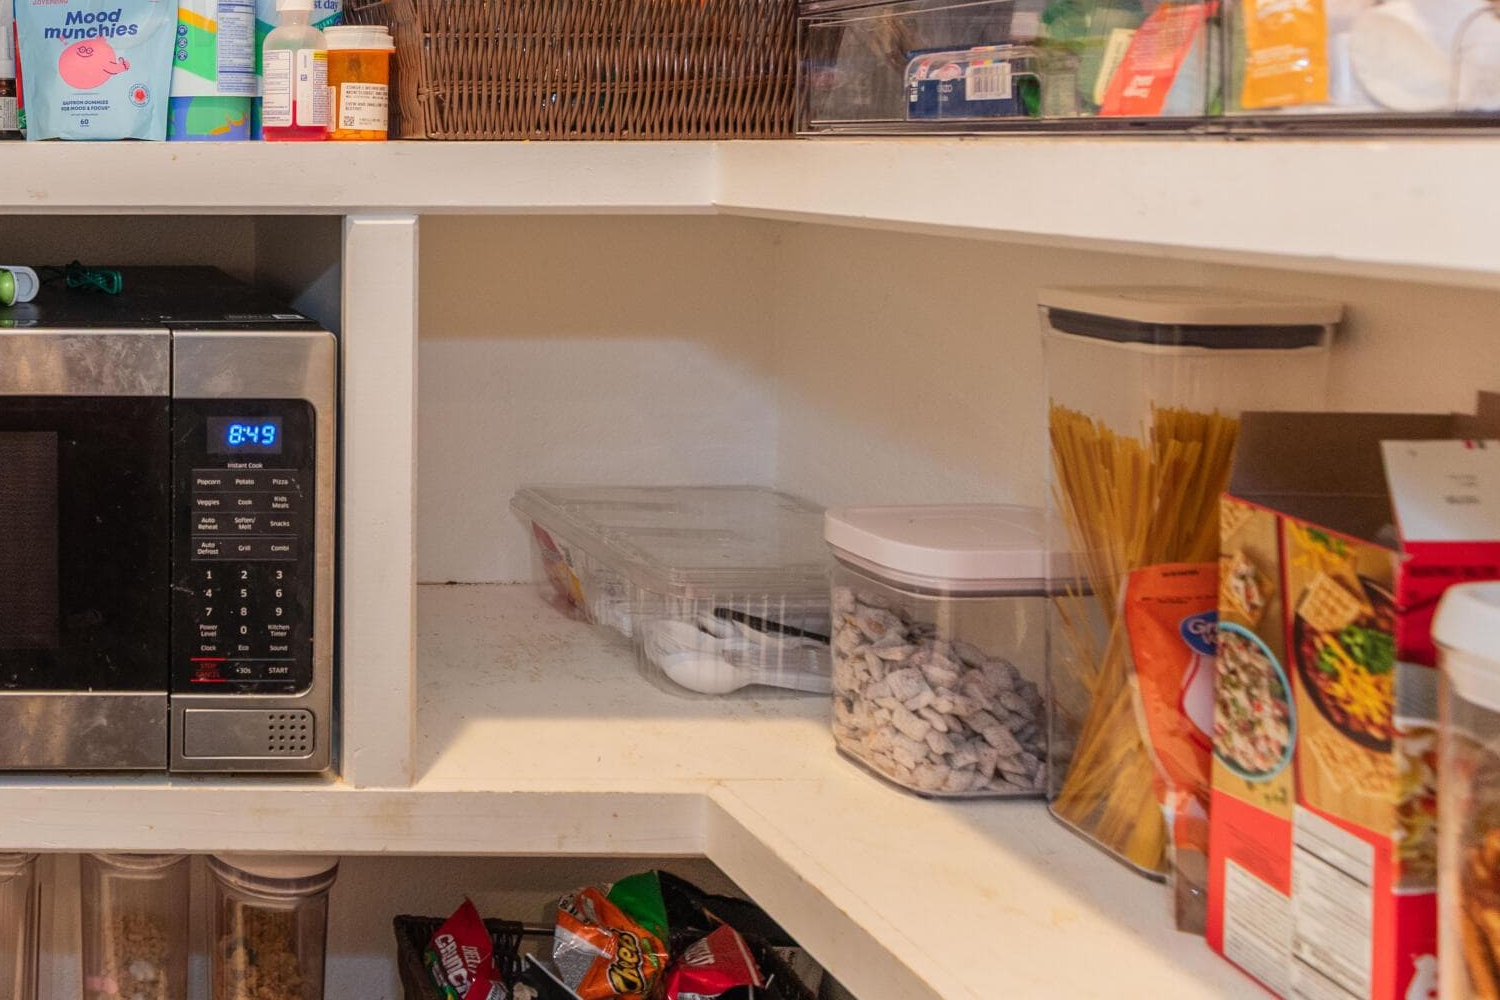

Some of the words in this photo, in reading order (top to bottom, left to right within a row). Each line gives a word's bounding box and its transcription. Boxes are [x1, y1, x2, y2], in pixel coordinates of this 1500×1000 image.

[65, 8, 122, 26] Mood
[44, 23, 139, 39] munchies
[228, 424, 276, 444] 8:49
[207, 571, 212, 579] 1
[241, 571, 247, 579] 2
[276, 571, 283, 579] 3
[205, 589, 212, 597] 4
[241, 589, 247, 597] 5
[275, 589, 282, 597] 6
[205, 608, 212, 616] 7
[240, 608, 247, 616] 8
[275, 608, 282, 616] 9
[240, 626, 247, 634] 0
